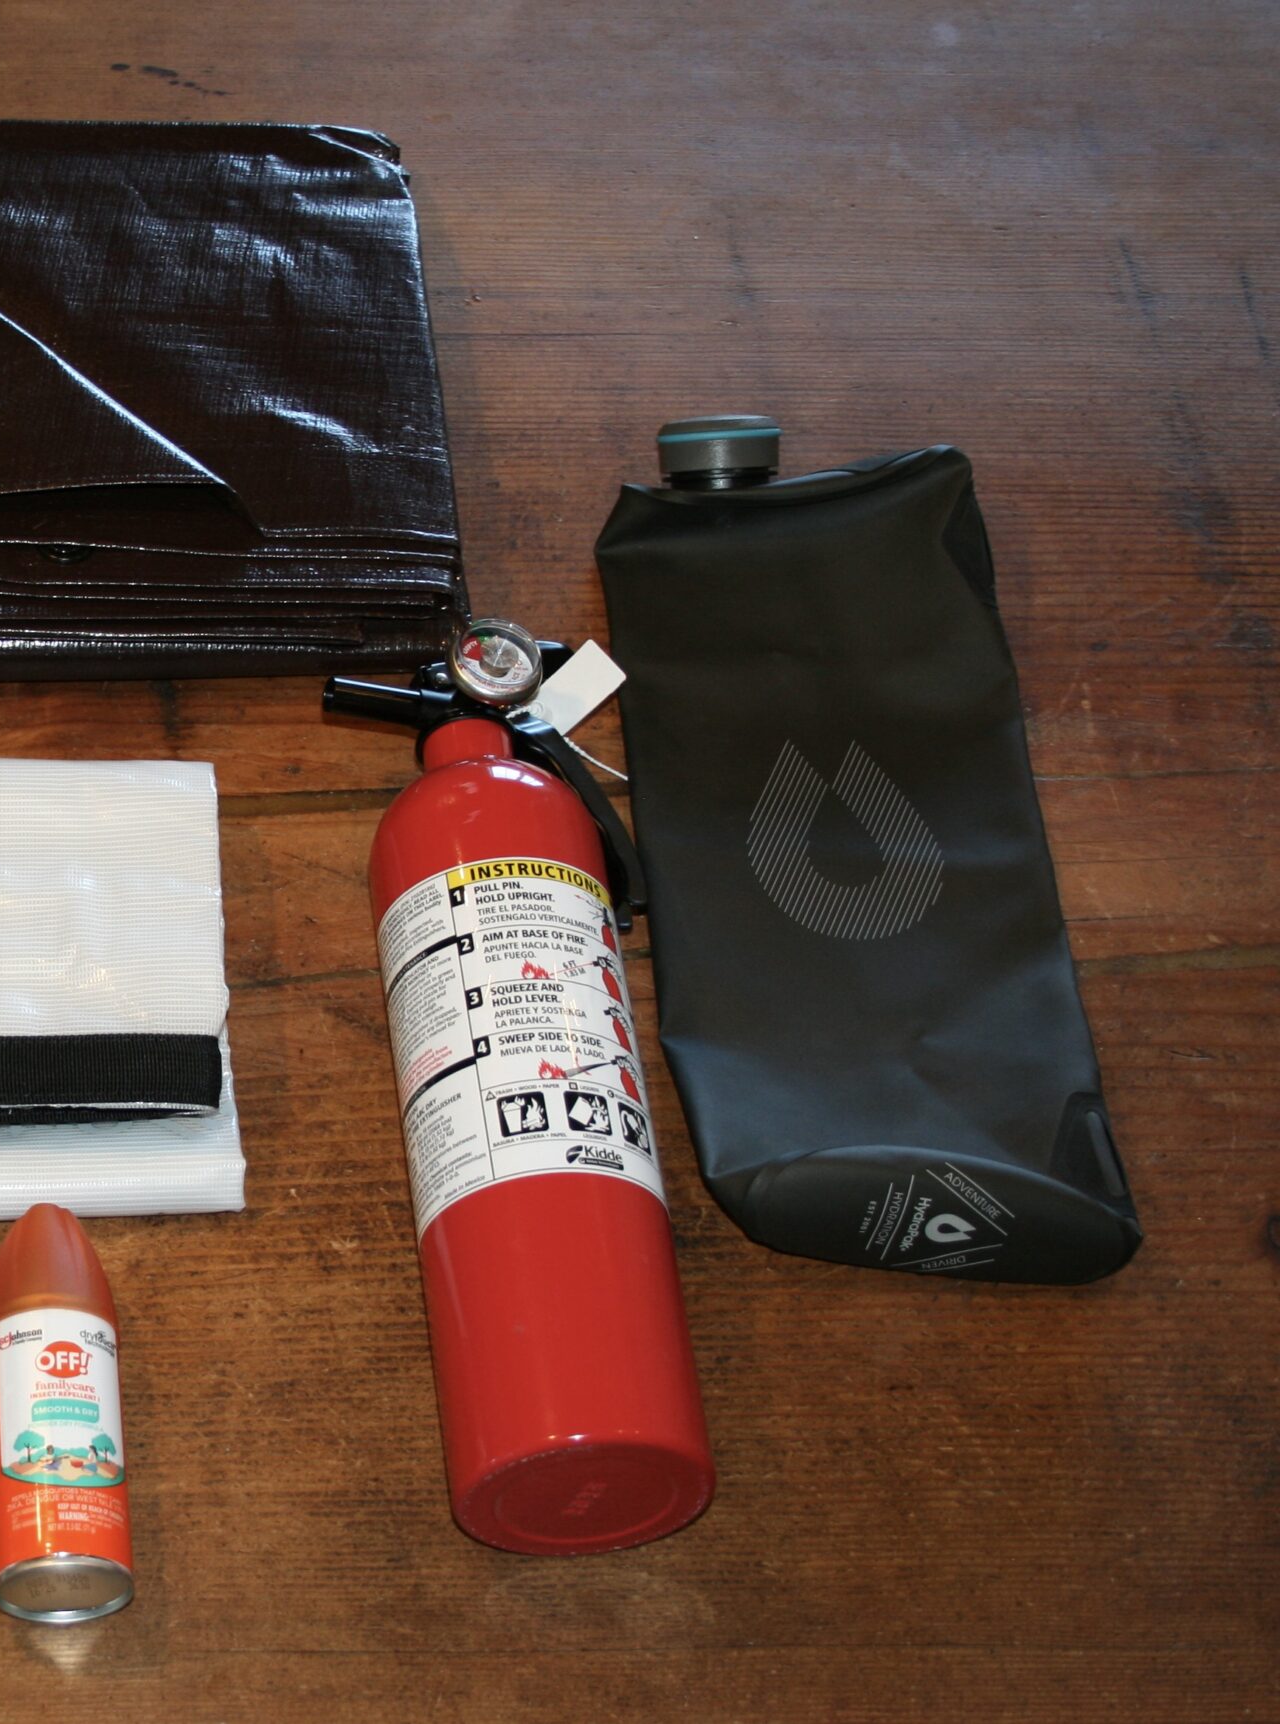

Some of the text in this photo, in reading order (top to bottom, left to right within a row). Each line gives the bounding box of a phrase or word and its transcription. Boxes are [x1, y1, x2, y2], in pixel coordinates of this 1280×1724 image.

[470, 863, 601, 897] INSTRUCTIONS
[474, 881, 523, 894] PULL PIN.
[453, 890, 462, 902] 1
[475, 892, 555, 905] HOLD UPRIGHT.
[477, 903, 555, 916] TIRE EL PASADOR.
[479, 913, 599, 936] SOSTENGALO VERTICALMENTE.
[482, 930, 588, 946] AIM AT BASE OF FIRE.
[461, 939, 471, 951] 2
[484, 941, 583, 955] APUNTE HACIA LA BASE
[485, 950, 536, 963] DEL FUEGO.
[490, 983, 564, 996] SQUEEZE AND
[469, 992, 479, 1005] 3
[492, 994, 560, 1007] HOLD LEVER.
[494, 1006, 530, 1019] APRIETE
[533, 1006, 540, 1014] Y
[496, 1015, 554, 1029] LA PALANCA.
[477, 1041, 487, 1053] 4
[499, 1032, 605, 1049] SWEEP SIDE TO SIDE.
[500, 1045, 533, 1057] MUEVA
[535, 1044, 548, 1052] DE
[575, 1046, 582, 1054] A
[583, 1047, 606, 1060] LADO.
[584, 1145, 623, 1162] Kidde
[944, 1172, 1002, 1220] ADVENTURE
[874, 1192, 904, 1245] HYDRATION
[921, 1255, 966, 1270] DRIVEN
[35, 1350, 93, 1375] OFF!
[35, 1380, 95, 1393] familycare
[58, 1392, 96, 1401] REPELLENT
[33, 1406, 72, 1415] SMOOTH
[82, 1408, 98, 1417] DRY
[63, 1493, 75, 1501] OR
[79, 1494, 97, 1504] WEST
[58, 1512, 89, 1521] WARNING:
